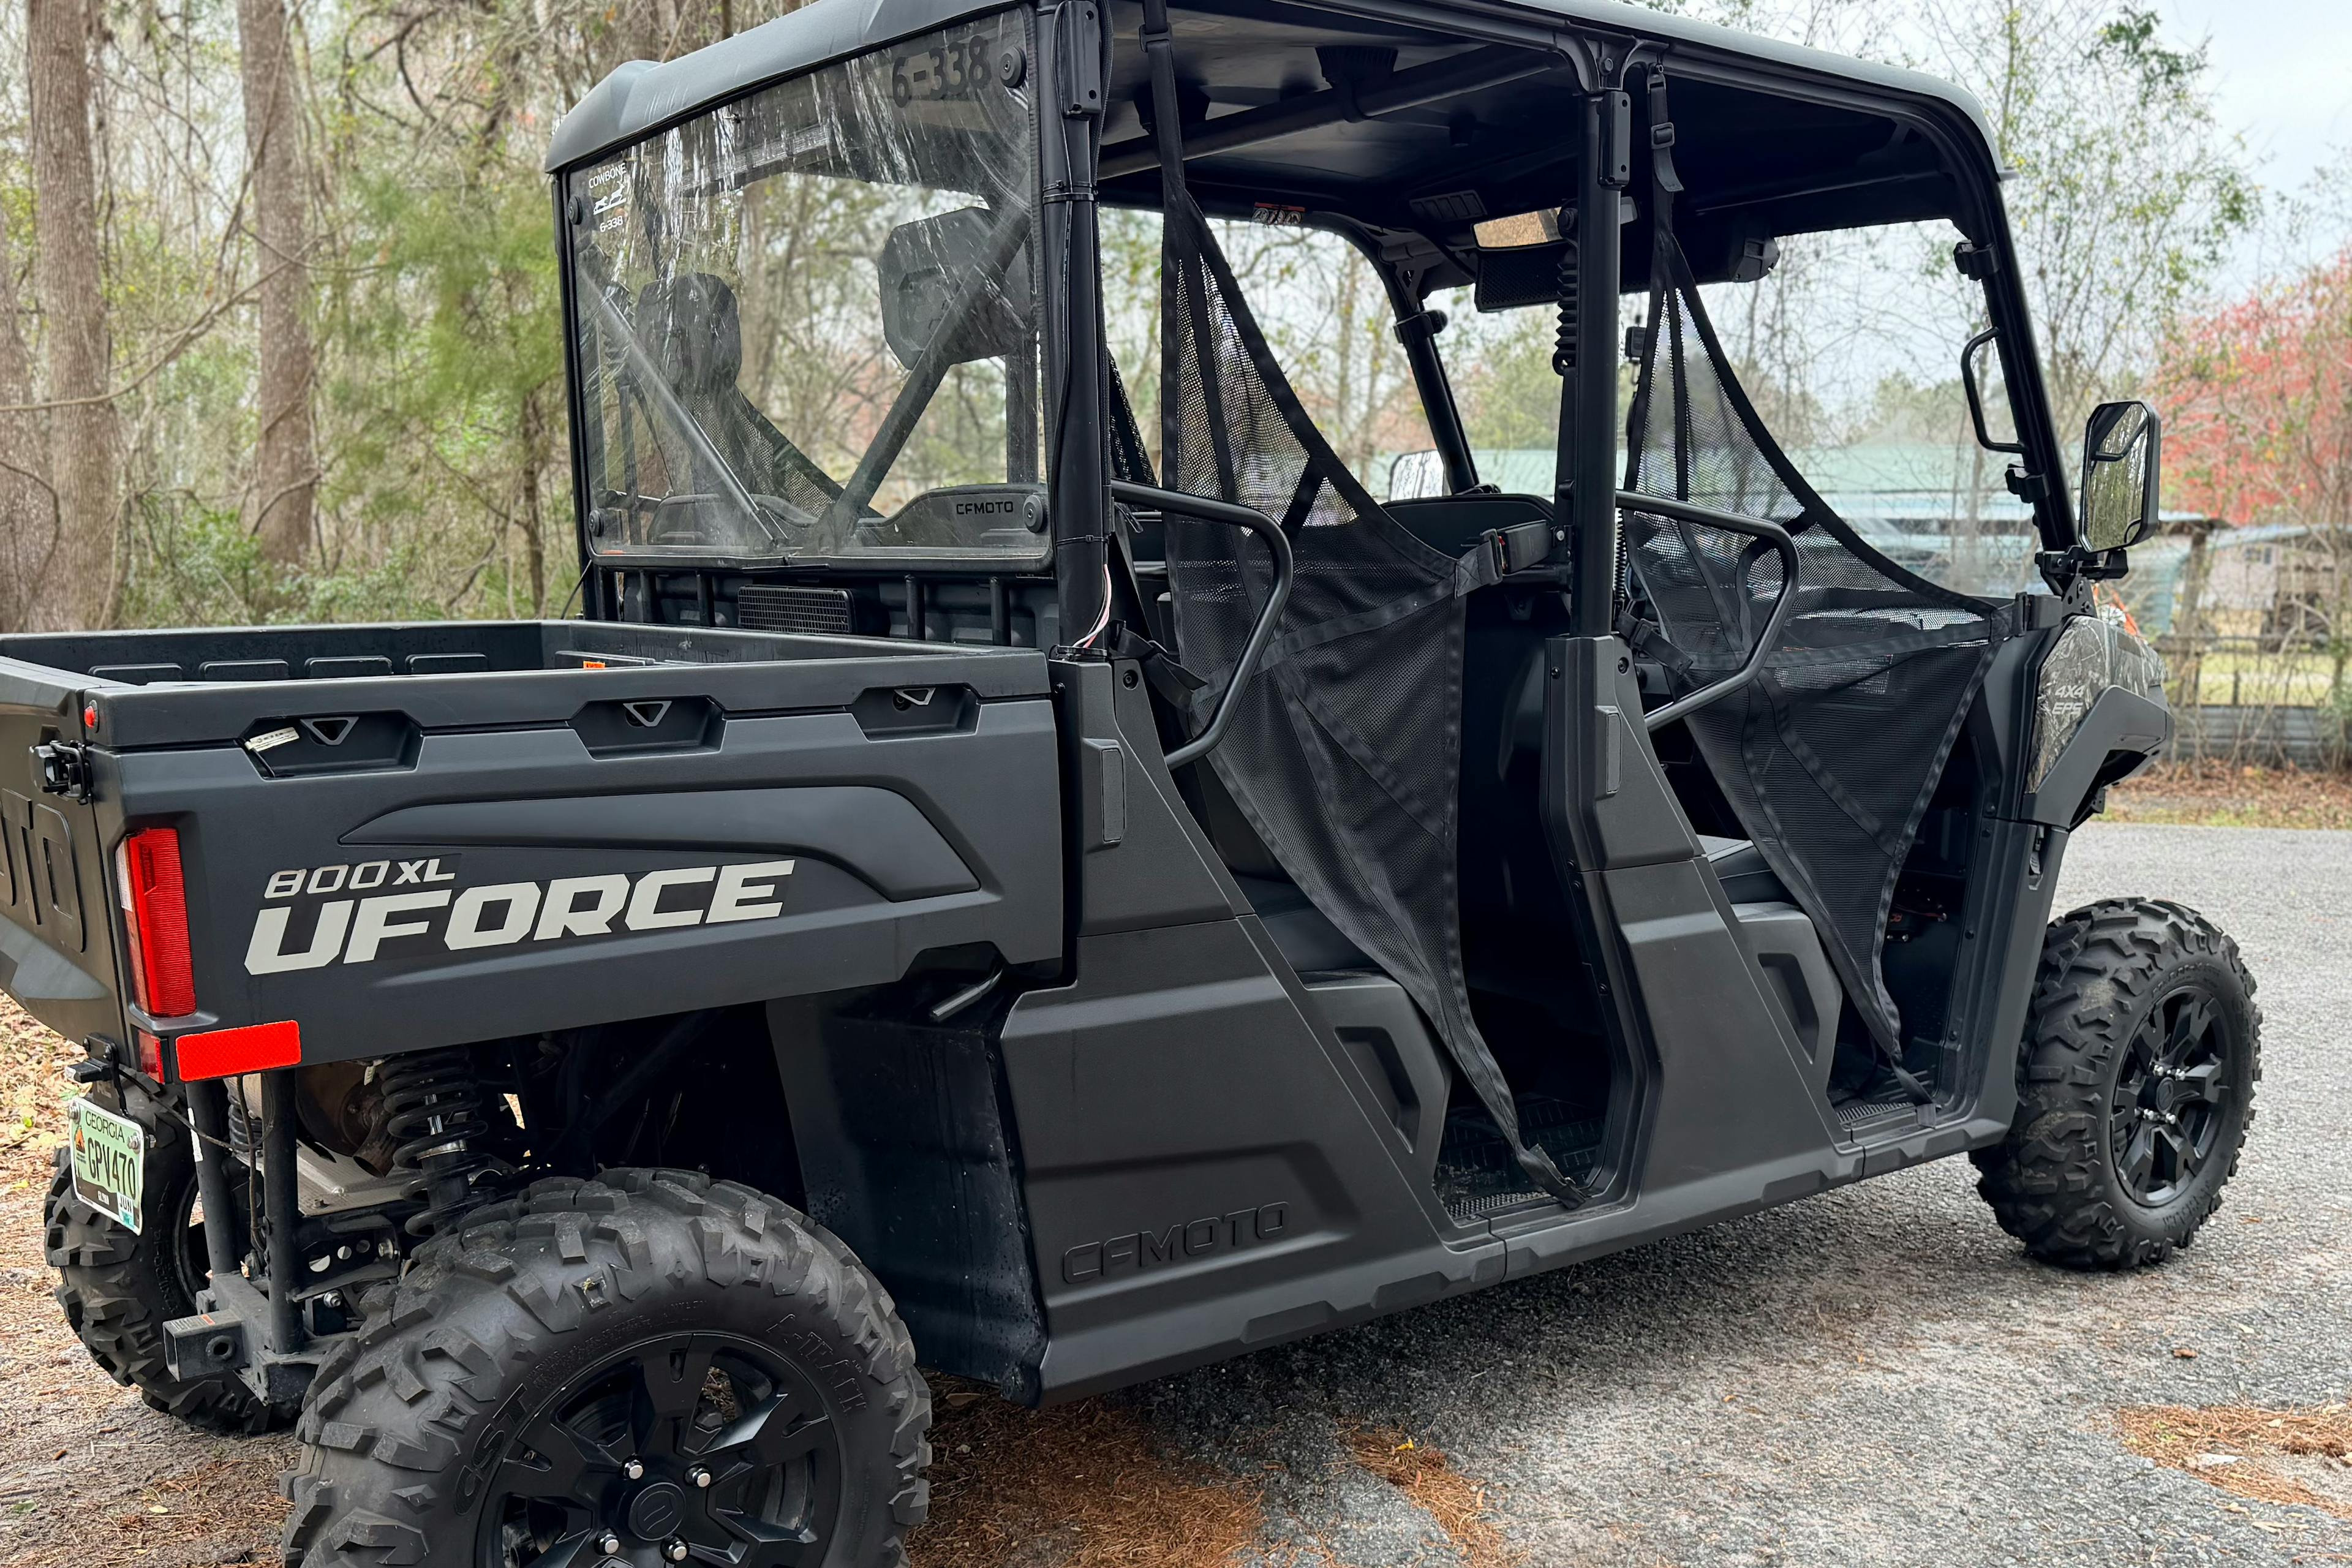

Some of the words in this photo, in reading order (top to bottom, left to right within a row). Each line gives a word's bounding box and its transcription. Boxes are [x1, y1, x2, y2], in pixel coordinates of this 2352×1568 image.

[892, 35, 992, 108] 6-338
[589, 162, 627, 189] COWBONE
[600, 216, 624, 232] 6-338
[956, 501, 1014, 514] CFMOTO
[2055, 685, 2085, 698] 4X4
[2052, 702, 2083, 715] EPS
[244, 859, 796, 975] UFORCE
[85, 1110, 125, 1144] GEORGIA
[88, 1137, 136, 1200] GPV470
[119, 1194, 132, 1214] JUN
[1063, 1201, 1289, 1284] CFMOTO
[454, 1382, 527, 1516] CST
